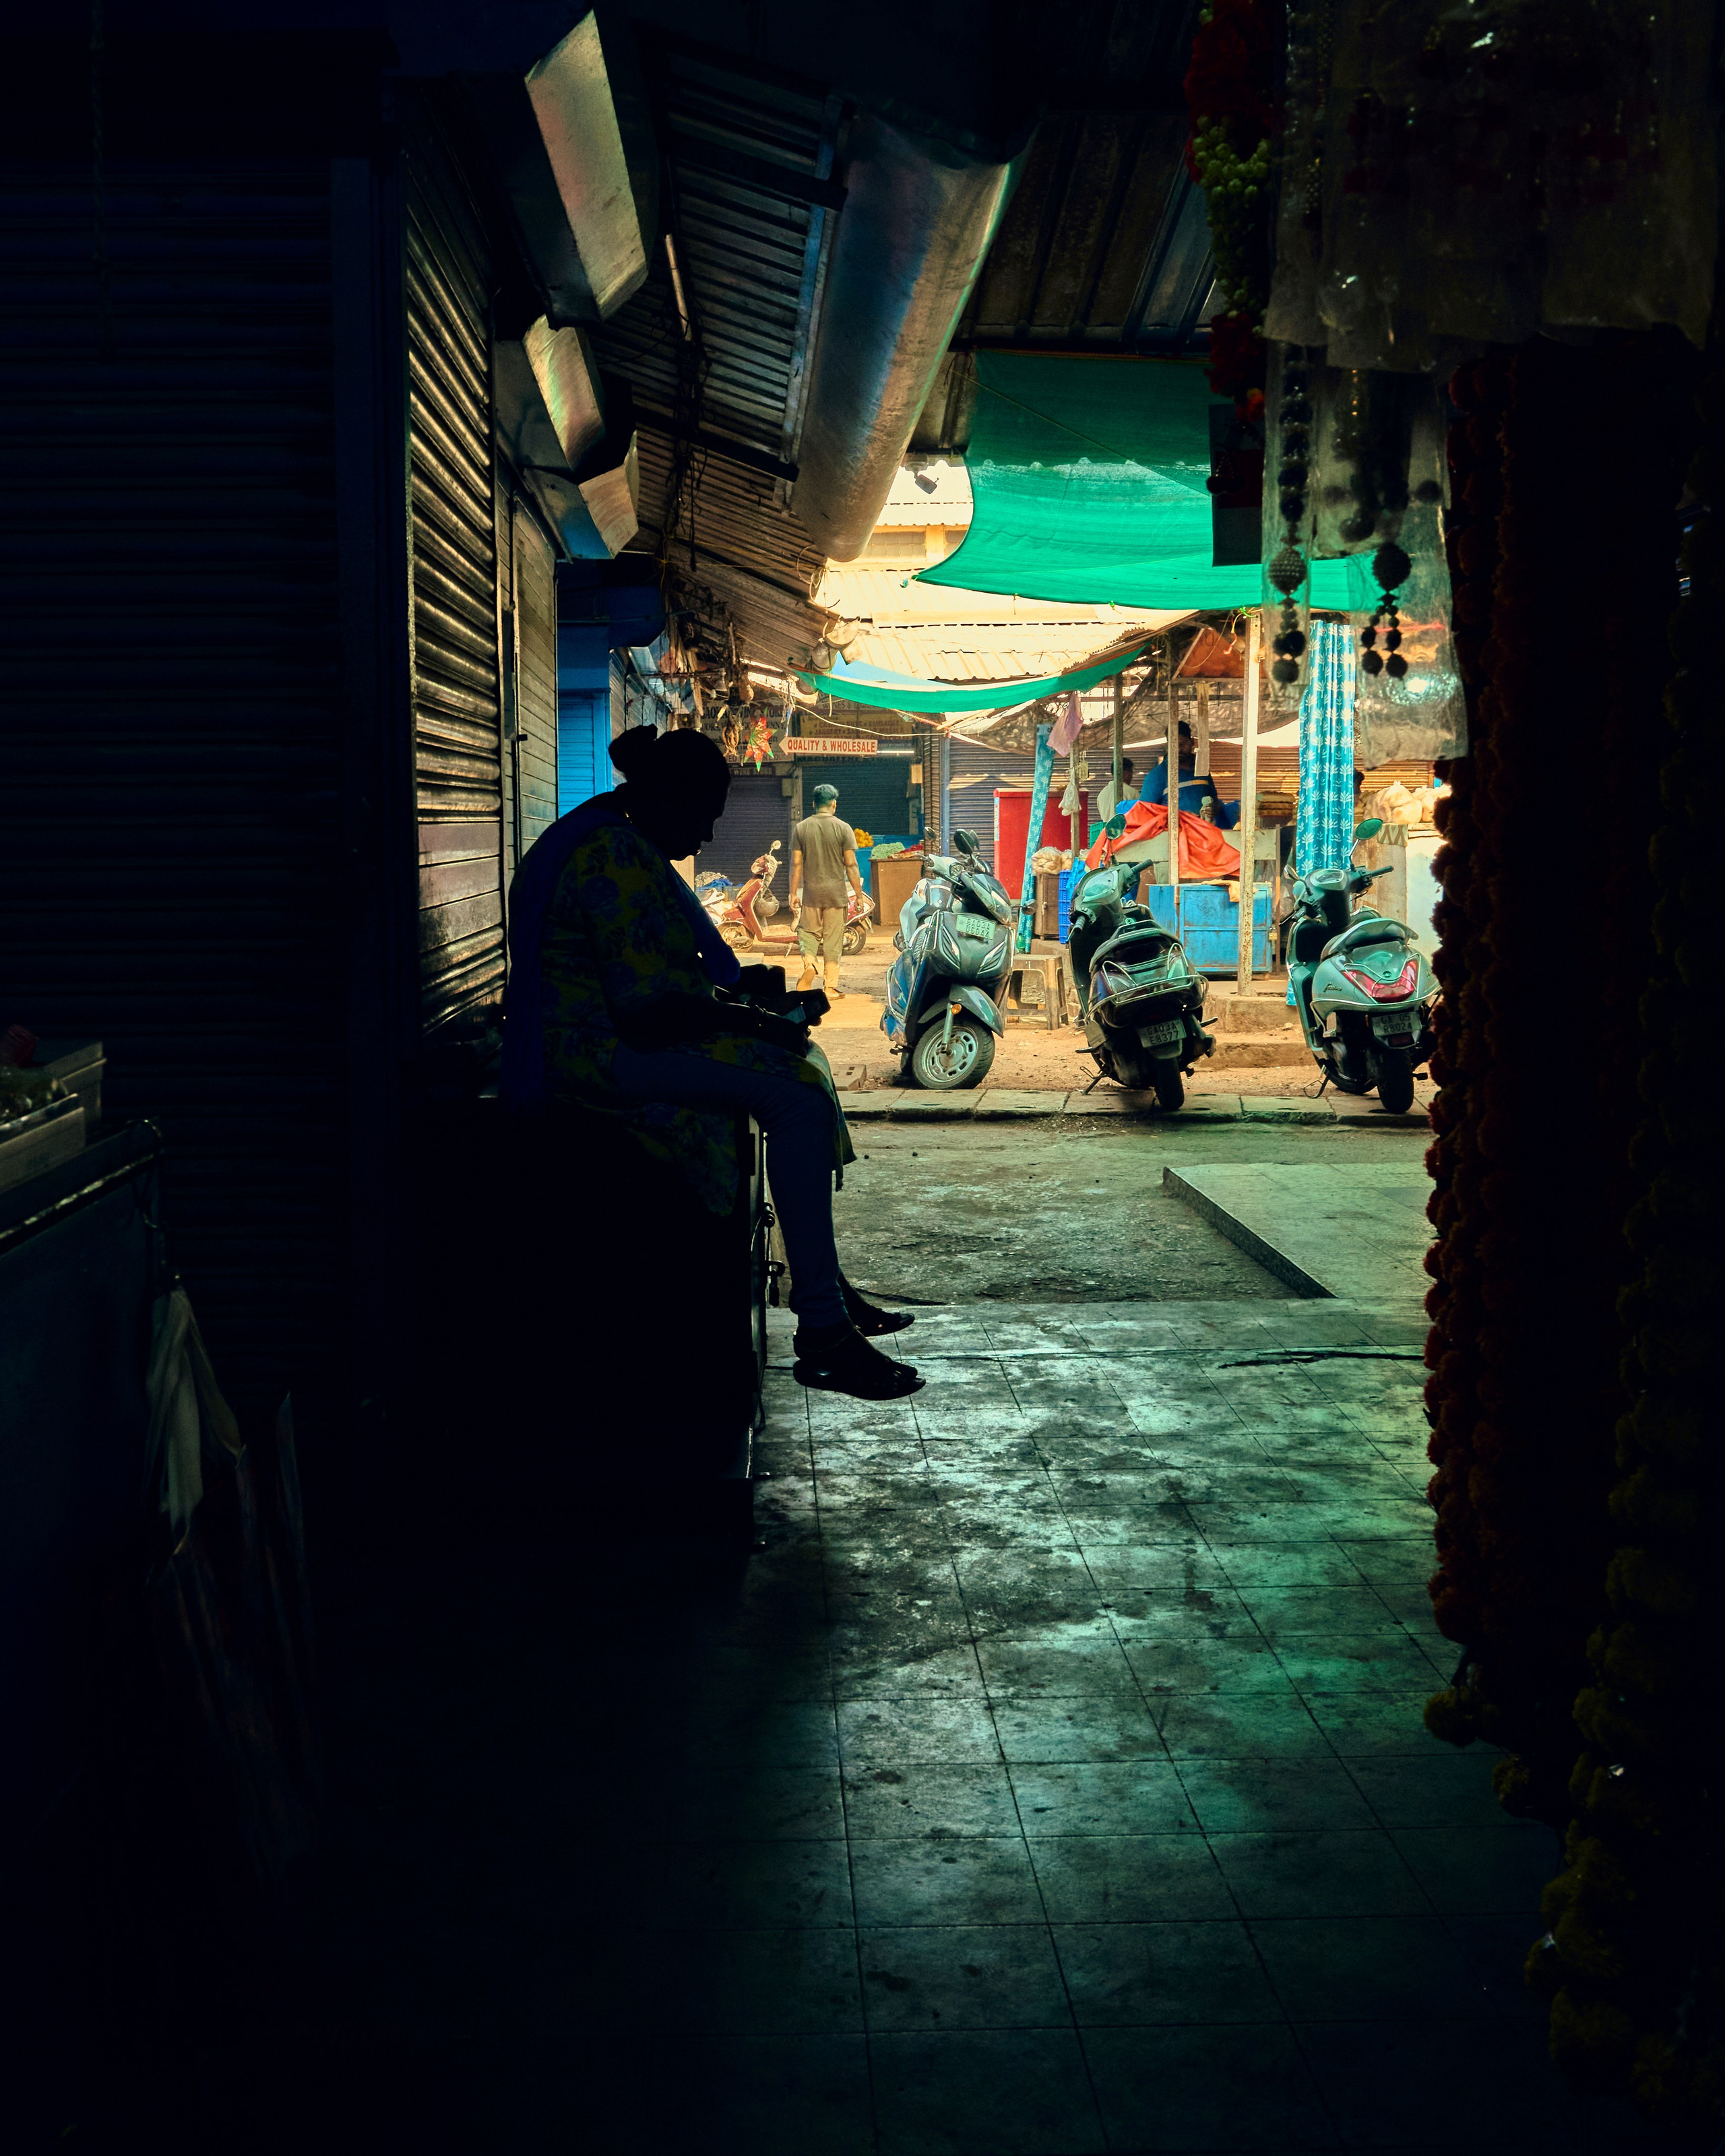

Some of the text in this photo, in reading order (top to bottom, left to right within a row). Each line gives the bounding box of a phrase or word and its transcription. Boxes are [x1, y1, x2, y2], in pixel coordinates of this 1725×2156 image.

[788, 739, 820, 751] QUALITY
[822, 740, 827, 751] &
[830, 740, 875, 753] WHOLESALE
[1147, 1021, 1177, 1036] GA03A
[1150, 1030, 1179, 1045] E8377
